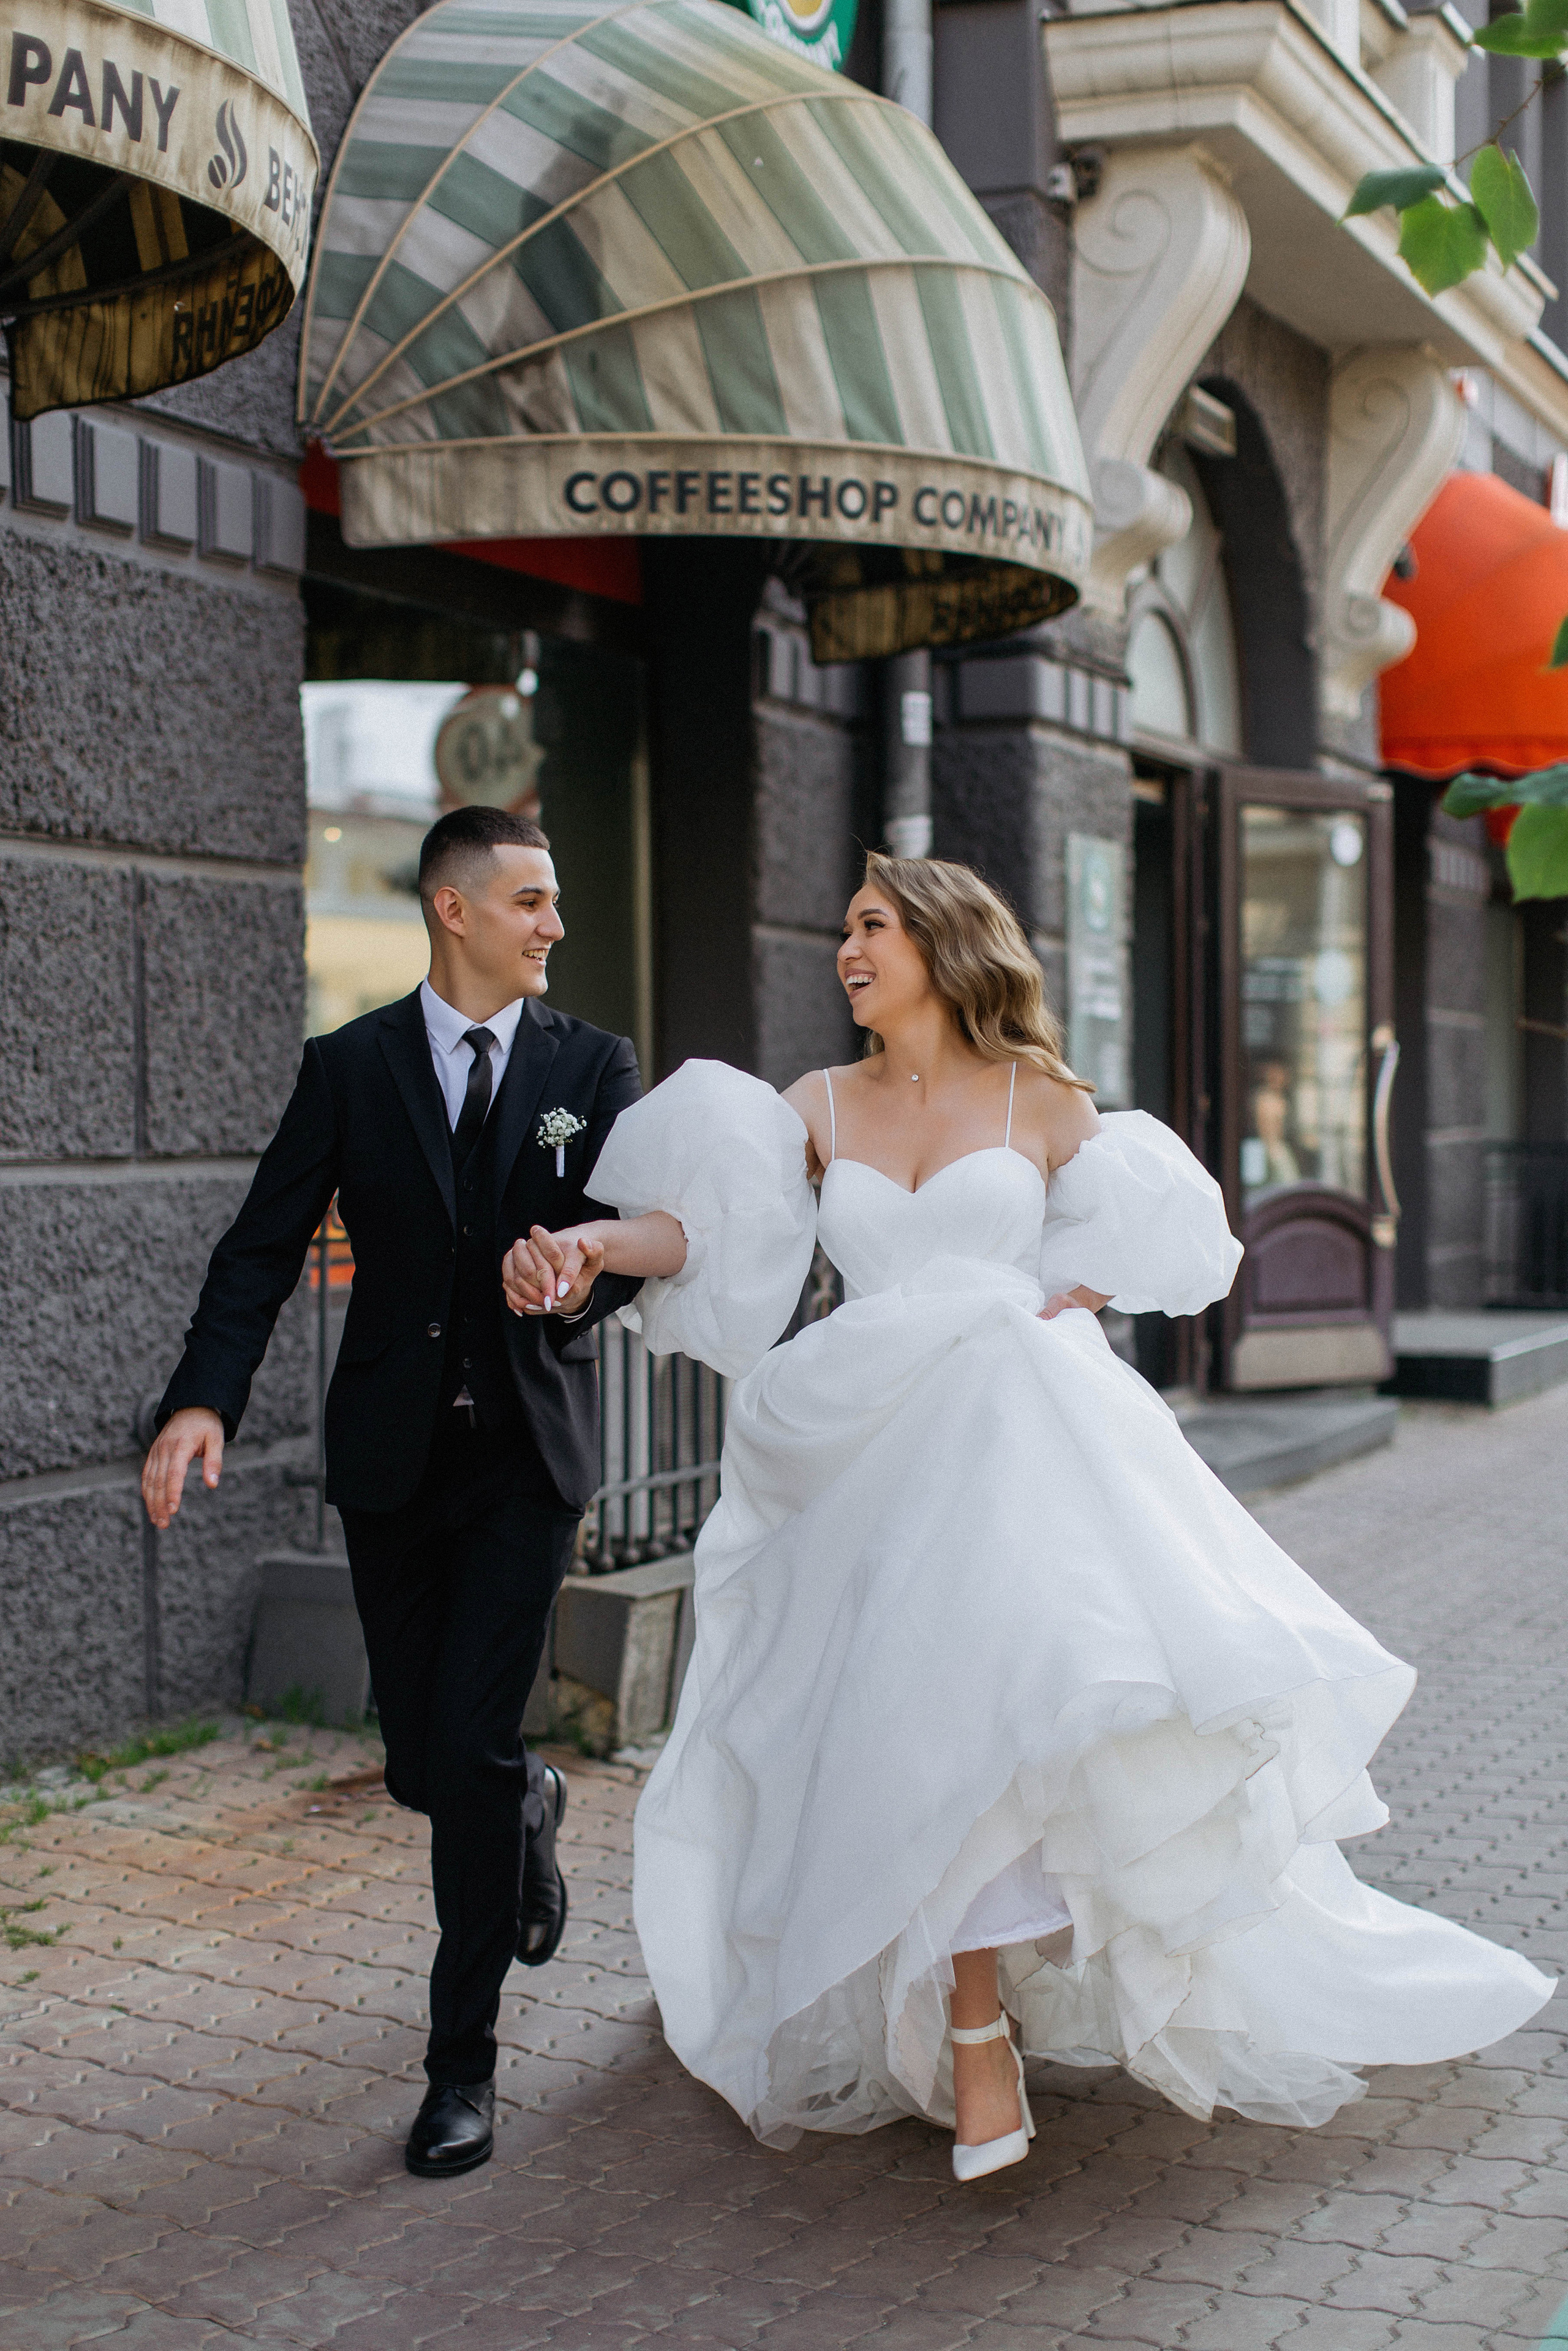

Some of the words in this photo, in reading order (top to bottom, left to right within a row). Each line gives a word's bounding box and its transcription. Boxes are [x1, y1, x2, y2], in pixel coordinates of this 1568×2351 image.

[7, 31, 181, 153] PANY
[564, 470, 898, 523] COFFEESHOP
[912, 486, 1065, 551] COMPANY
